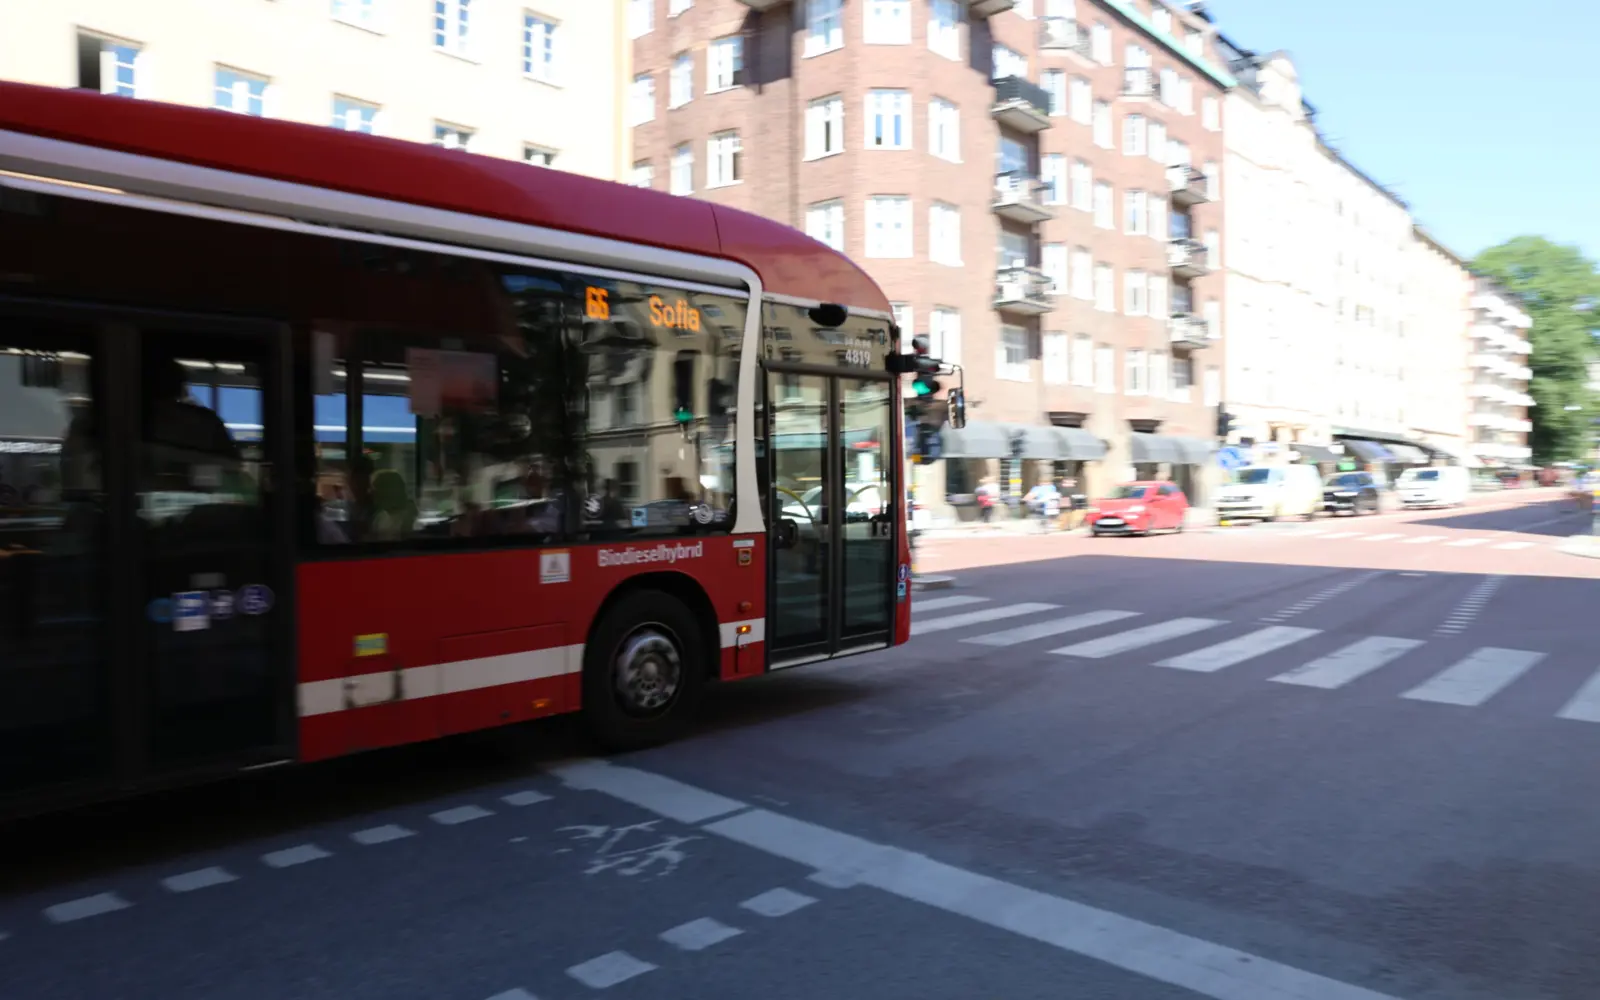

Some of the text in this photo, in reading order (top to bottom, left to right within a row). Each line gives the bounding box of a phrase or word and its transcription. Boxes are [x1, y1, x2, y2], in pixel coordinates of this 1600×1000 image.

[585, 285, 700, 332] 66 Sofia
[845, 349, 870, 365] 4819
[597, 541, 703, 567] Biodieselhybrid
